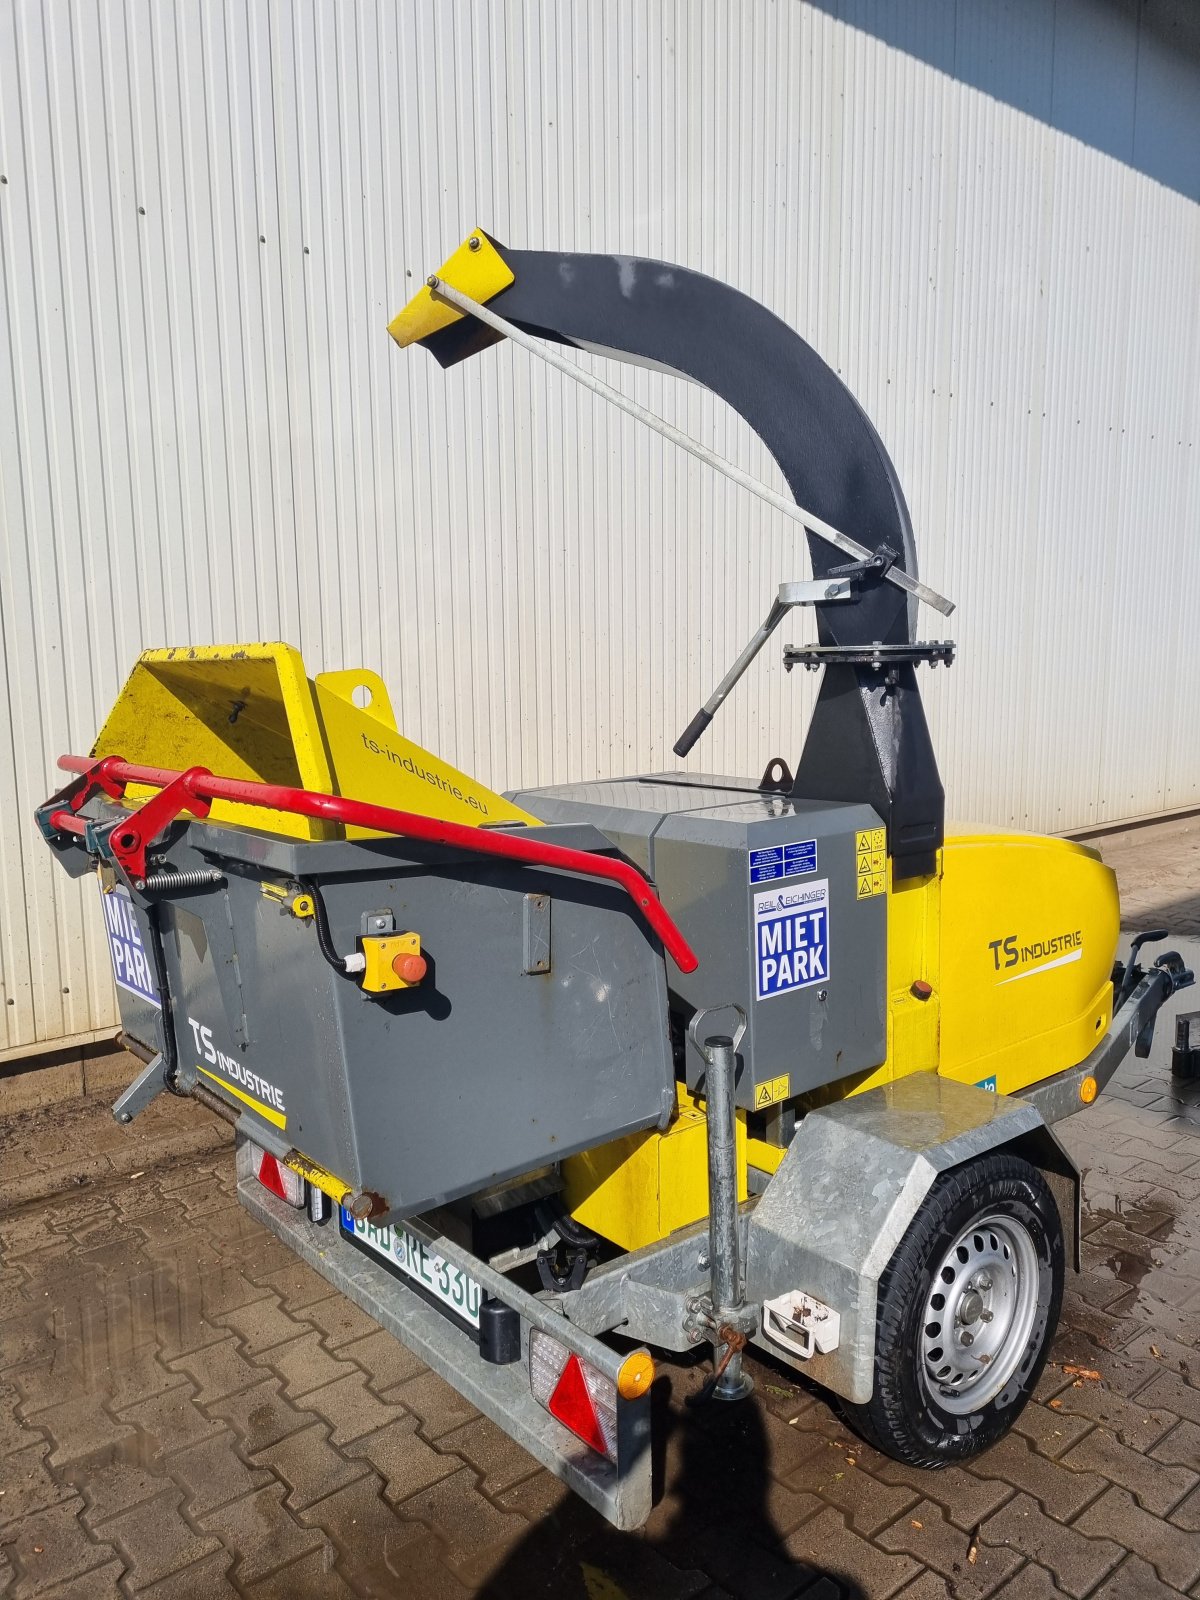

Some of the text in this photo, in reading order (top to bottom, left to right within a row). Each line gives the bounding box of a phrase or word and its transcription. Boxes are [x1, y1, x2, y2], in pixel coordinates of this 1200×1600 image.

[361, 732, 489, 816] ts-industrie.eu
[105, 894, 141, 946] MIE
[761, 911, 824, 957] MIET
[762, 944, 825, 991] PARK
[988, 930, 1082, 971] TS INDUSTRIE
[188, 1017, 286, 1111] TS INDUSTRIE
